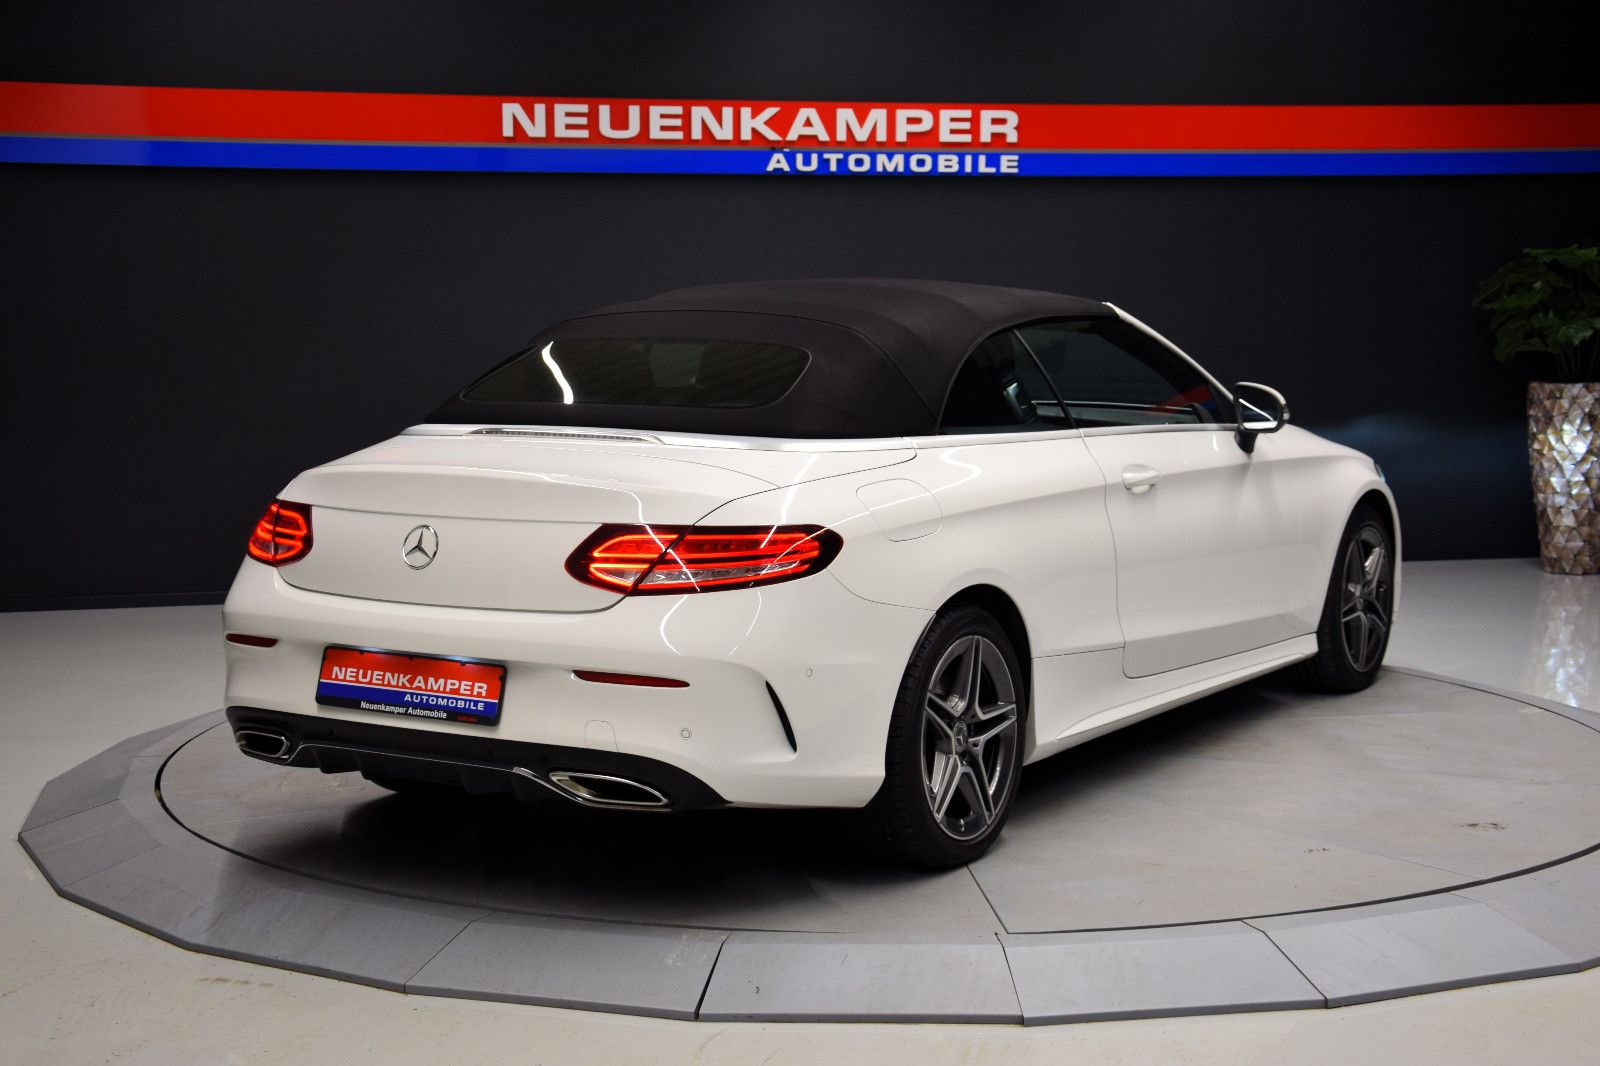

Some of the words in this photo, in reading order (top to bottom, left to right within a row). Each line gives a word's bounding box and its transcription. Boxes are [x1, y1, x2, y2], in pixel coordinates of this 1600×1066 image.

[501, 103, 1020, 144] NEUENKAMPER
[766, 152, 1020, 174] AUTOMOBILE
[331, 666, 488, 697] NEUENKAMPER
[360, 700, 407, 714] Neuenkamper
[407, 706, 447, 719] Automobile
[404, 693, 485, 711] AUTOMOBILE
